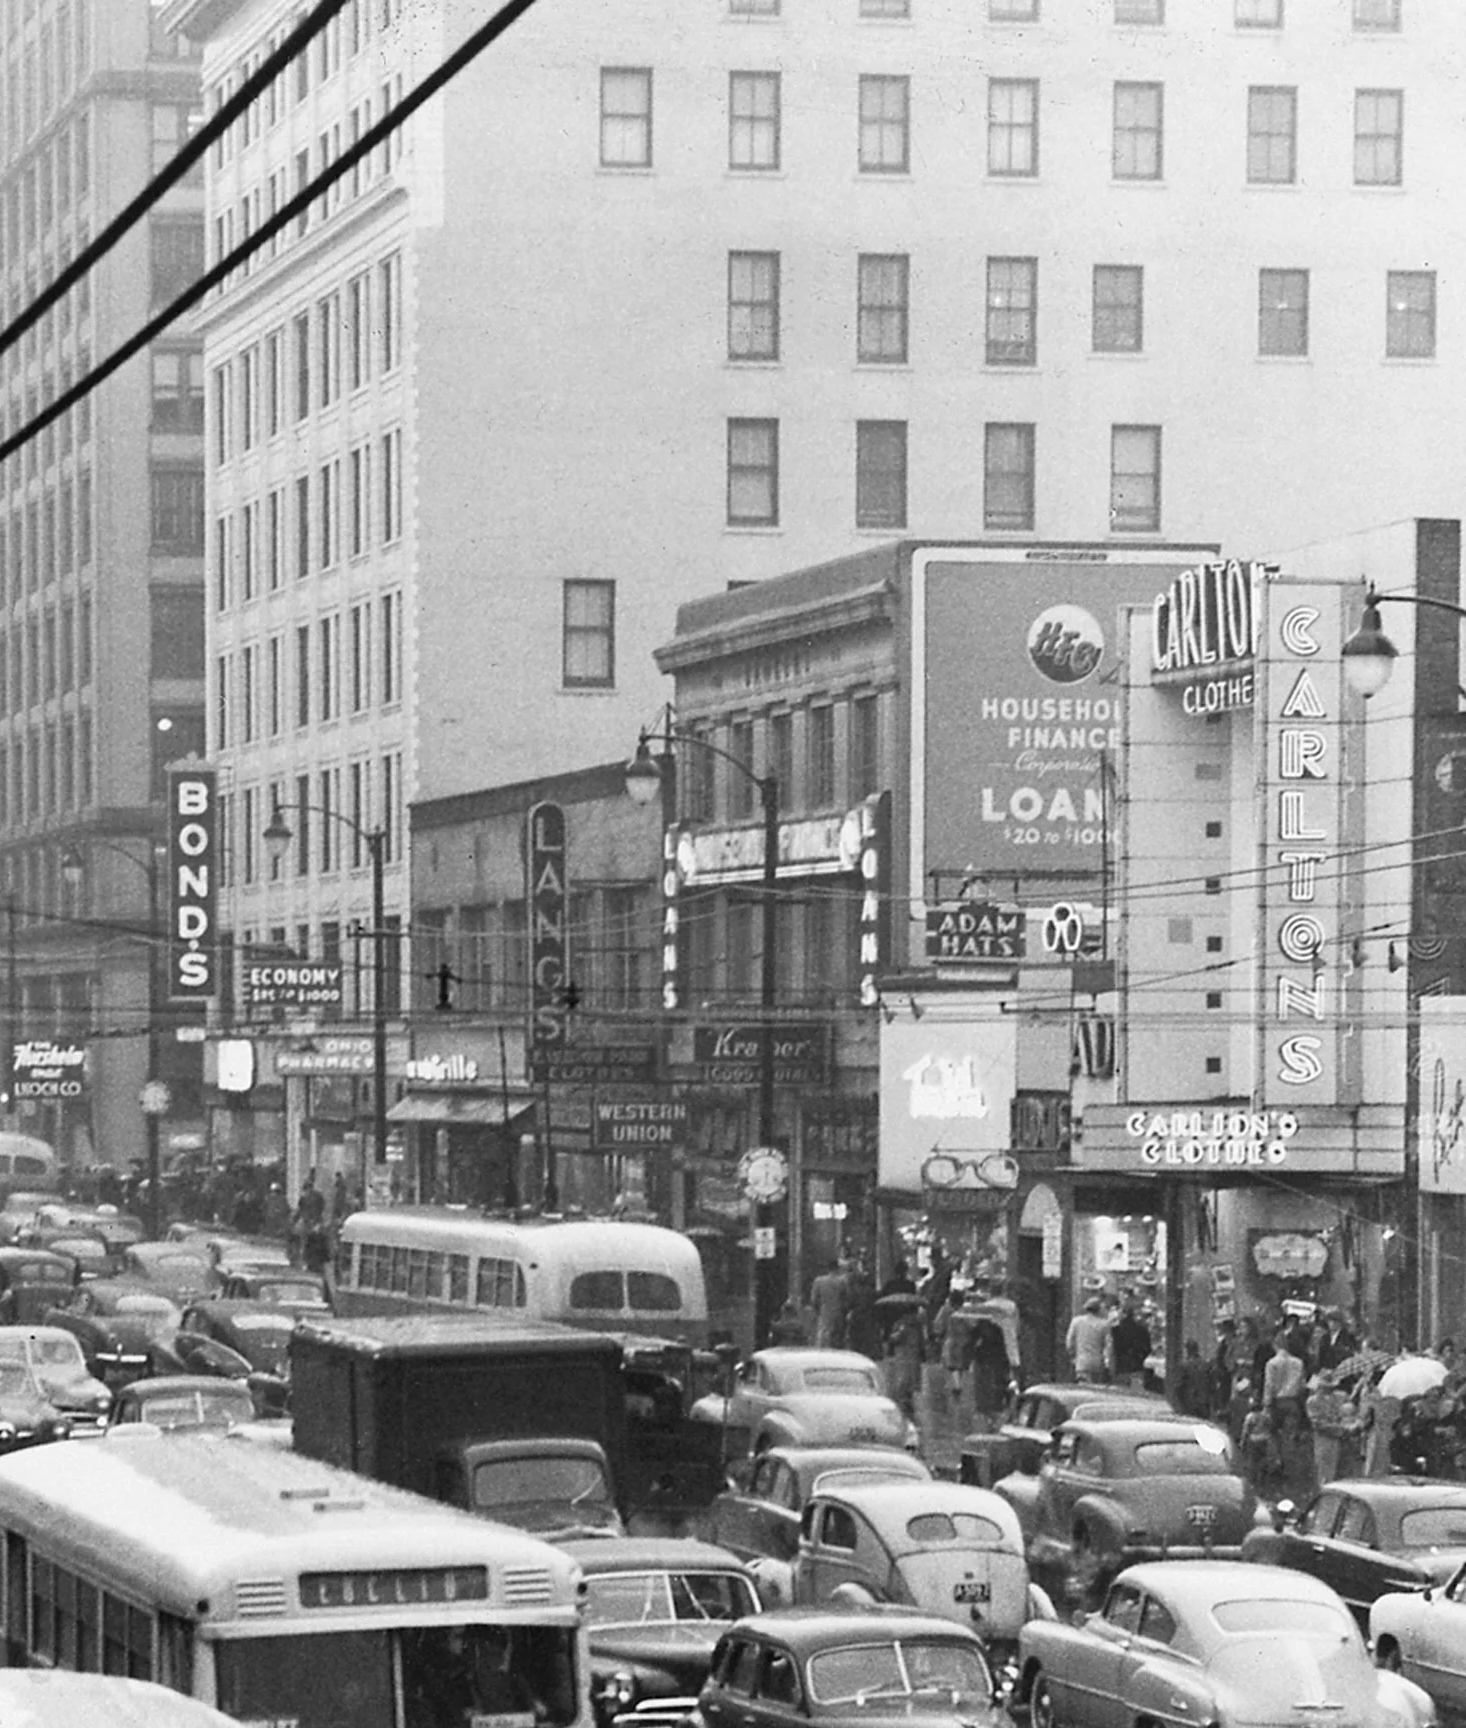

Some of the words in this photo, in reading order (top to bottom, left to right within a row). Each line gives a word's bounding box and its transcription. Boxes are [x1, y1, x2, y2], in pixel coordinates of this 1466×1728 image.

[1008, 727, 1121, 750] FINANCE
[1280, 605, 1327, 1085] CARLTONS
[939, 914, 1017, 934] ADAM
[941, 936, 1013, 956] HATS
[251, 968, 339, 985] ECONOMY
[598, 1104, 686, 1120] WESTERN
